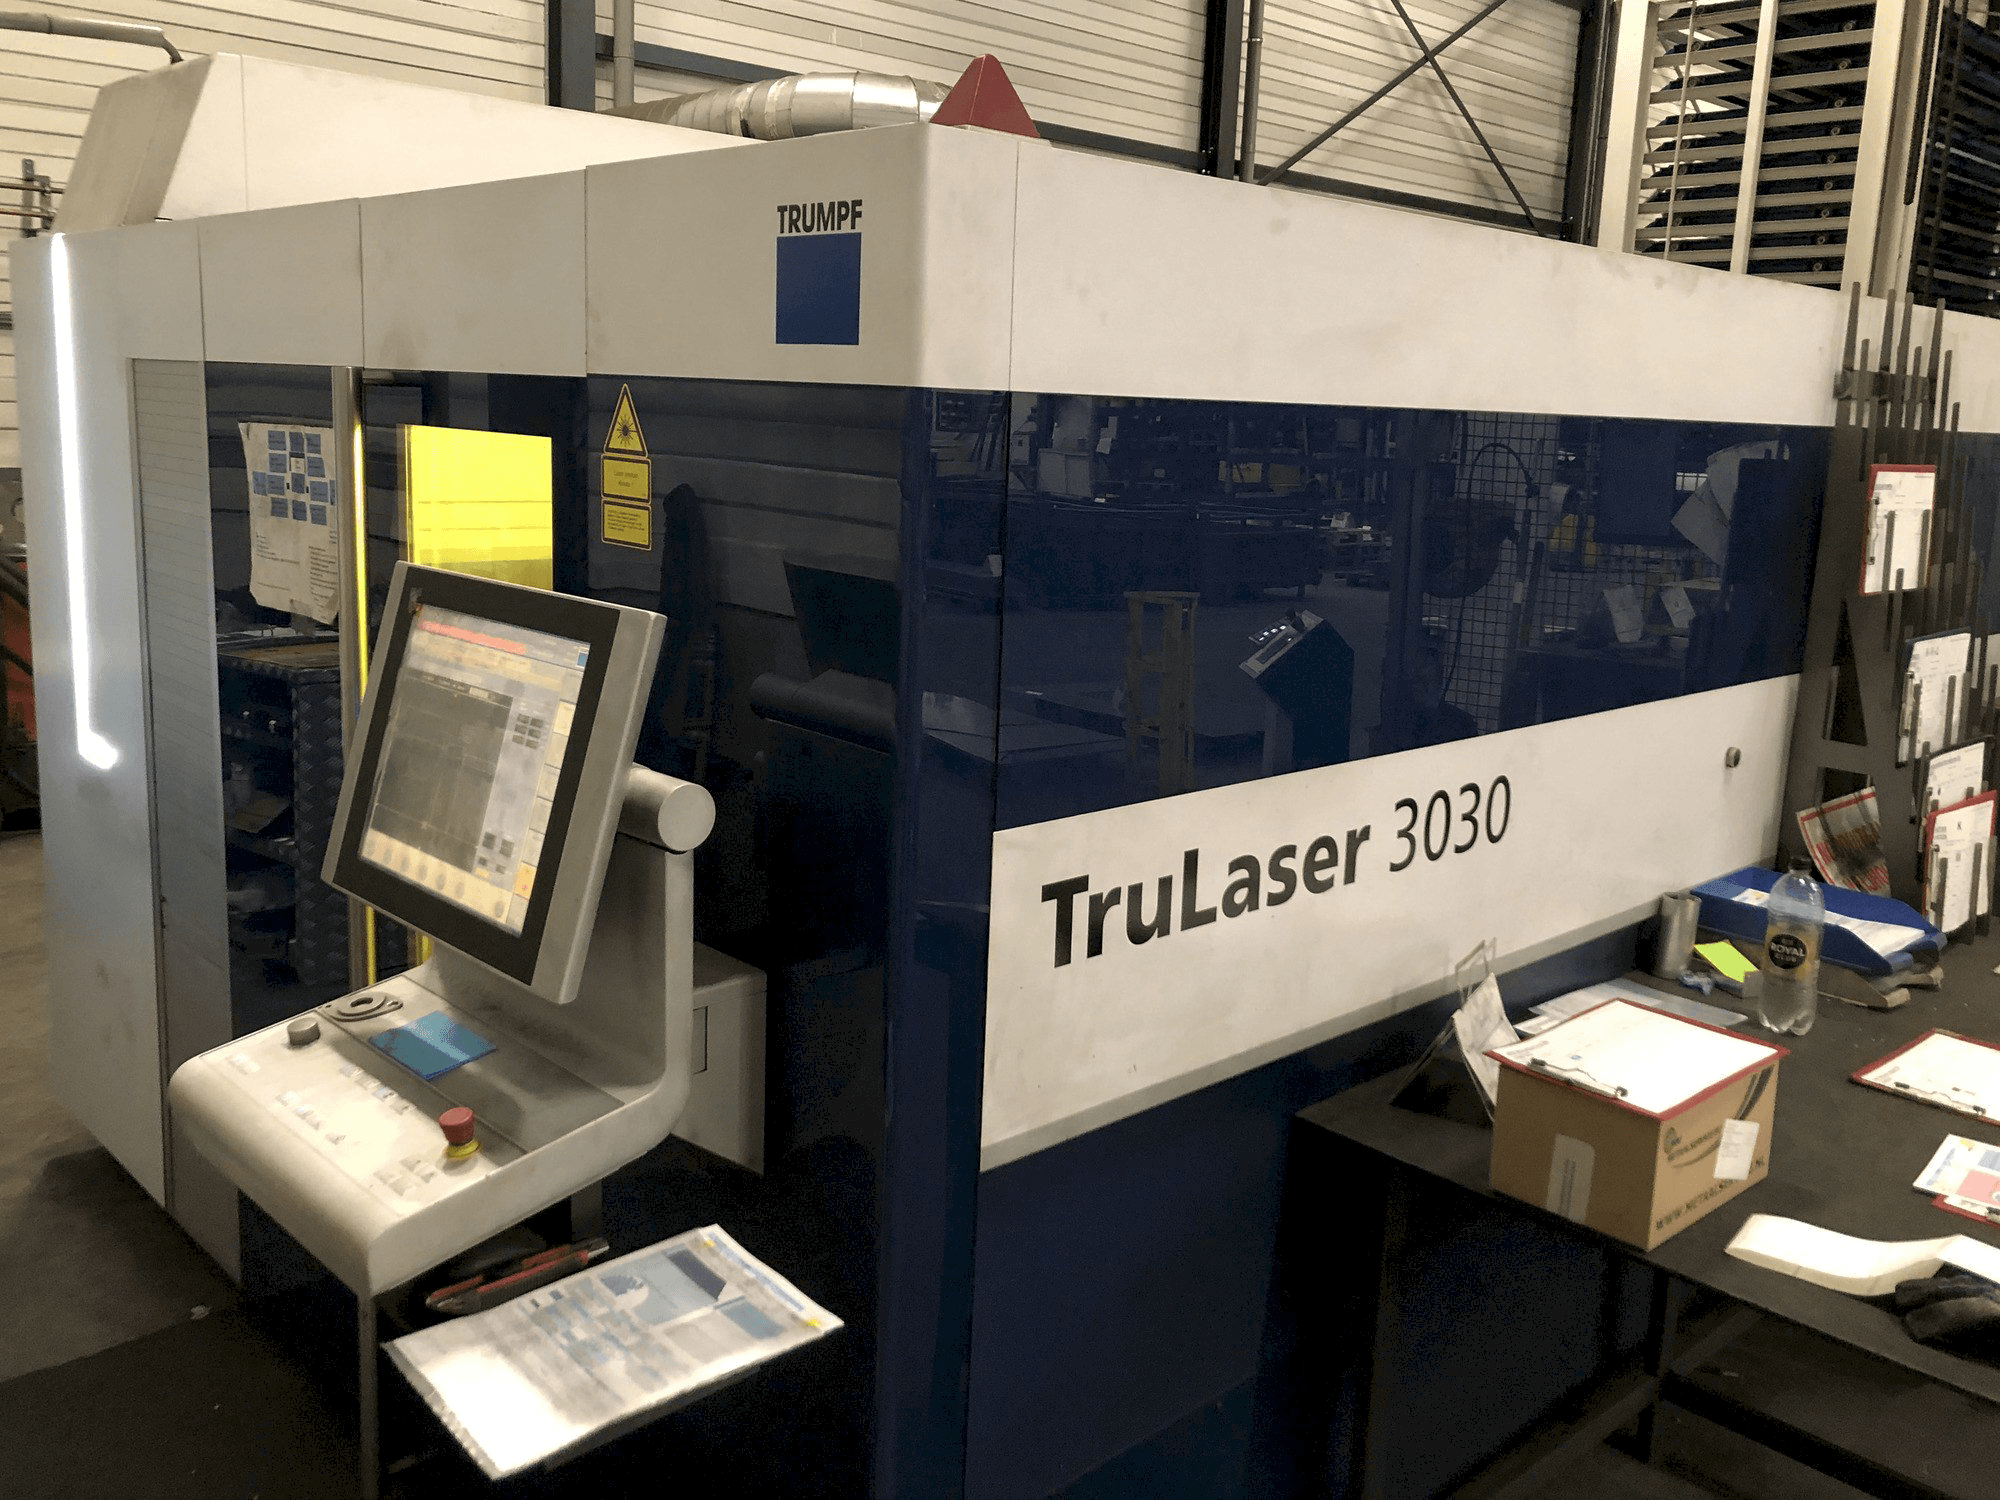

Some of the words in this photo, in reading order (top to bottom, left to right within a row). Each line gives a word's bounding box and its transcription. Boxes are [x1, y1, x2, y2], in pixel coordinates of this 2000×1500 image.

[777, 199, 863, 234] TRUMPF
[1041, 824, 1371, 968] TruLaser
[1389, 775, 1511, 872] 3030
[1770, 942, 1806, 957] ROYAL
